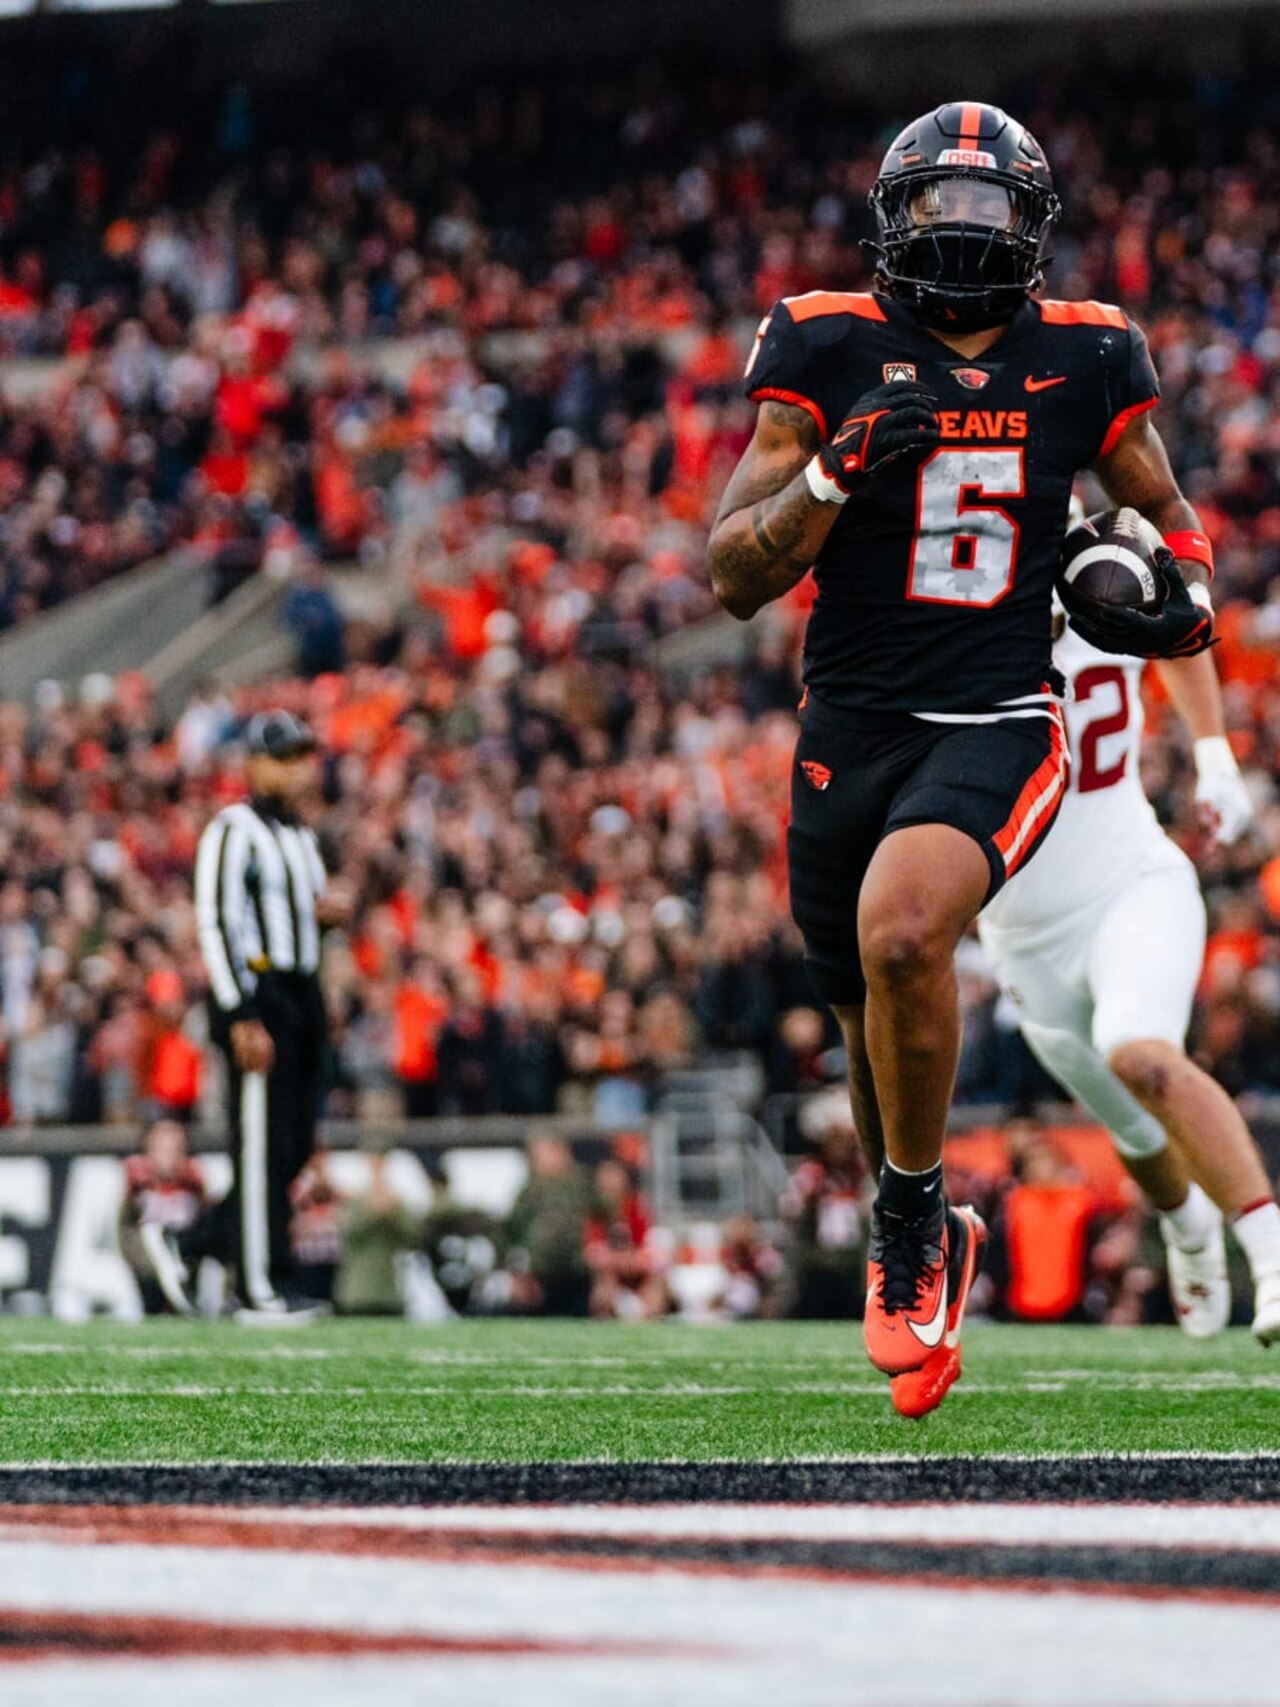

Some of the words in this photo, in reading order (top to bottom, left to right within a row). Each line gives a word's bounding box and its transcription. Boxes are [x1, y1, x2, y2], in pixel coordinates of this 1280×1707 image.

[934, 411, 1028, 439] EAVS
[906, 446, 1026, 609] 6
[1063, 664, 1129, 794] 2
